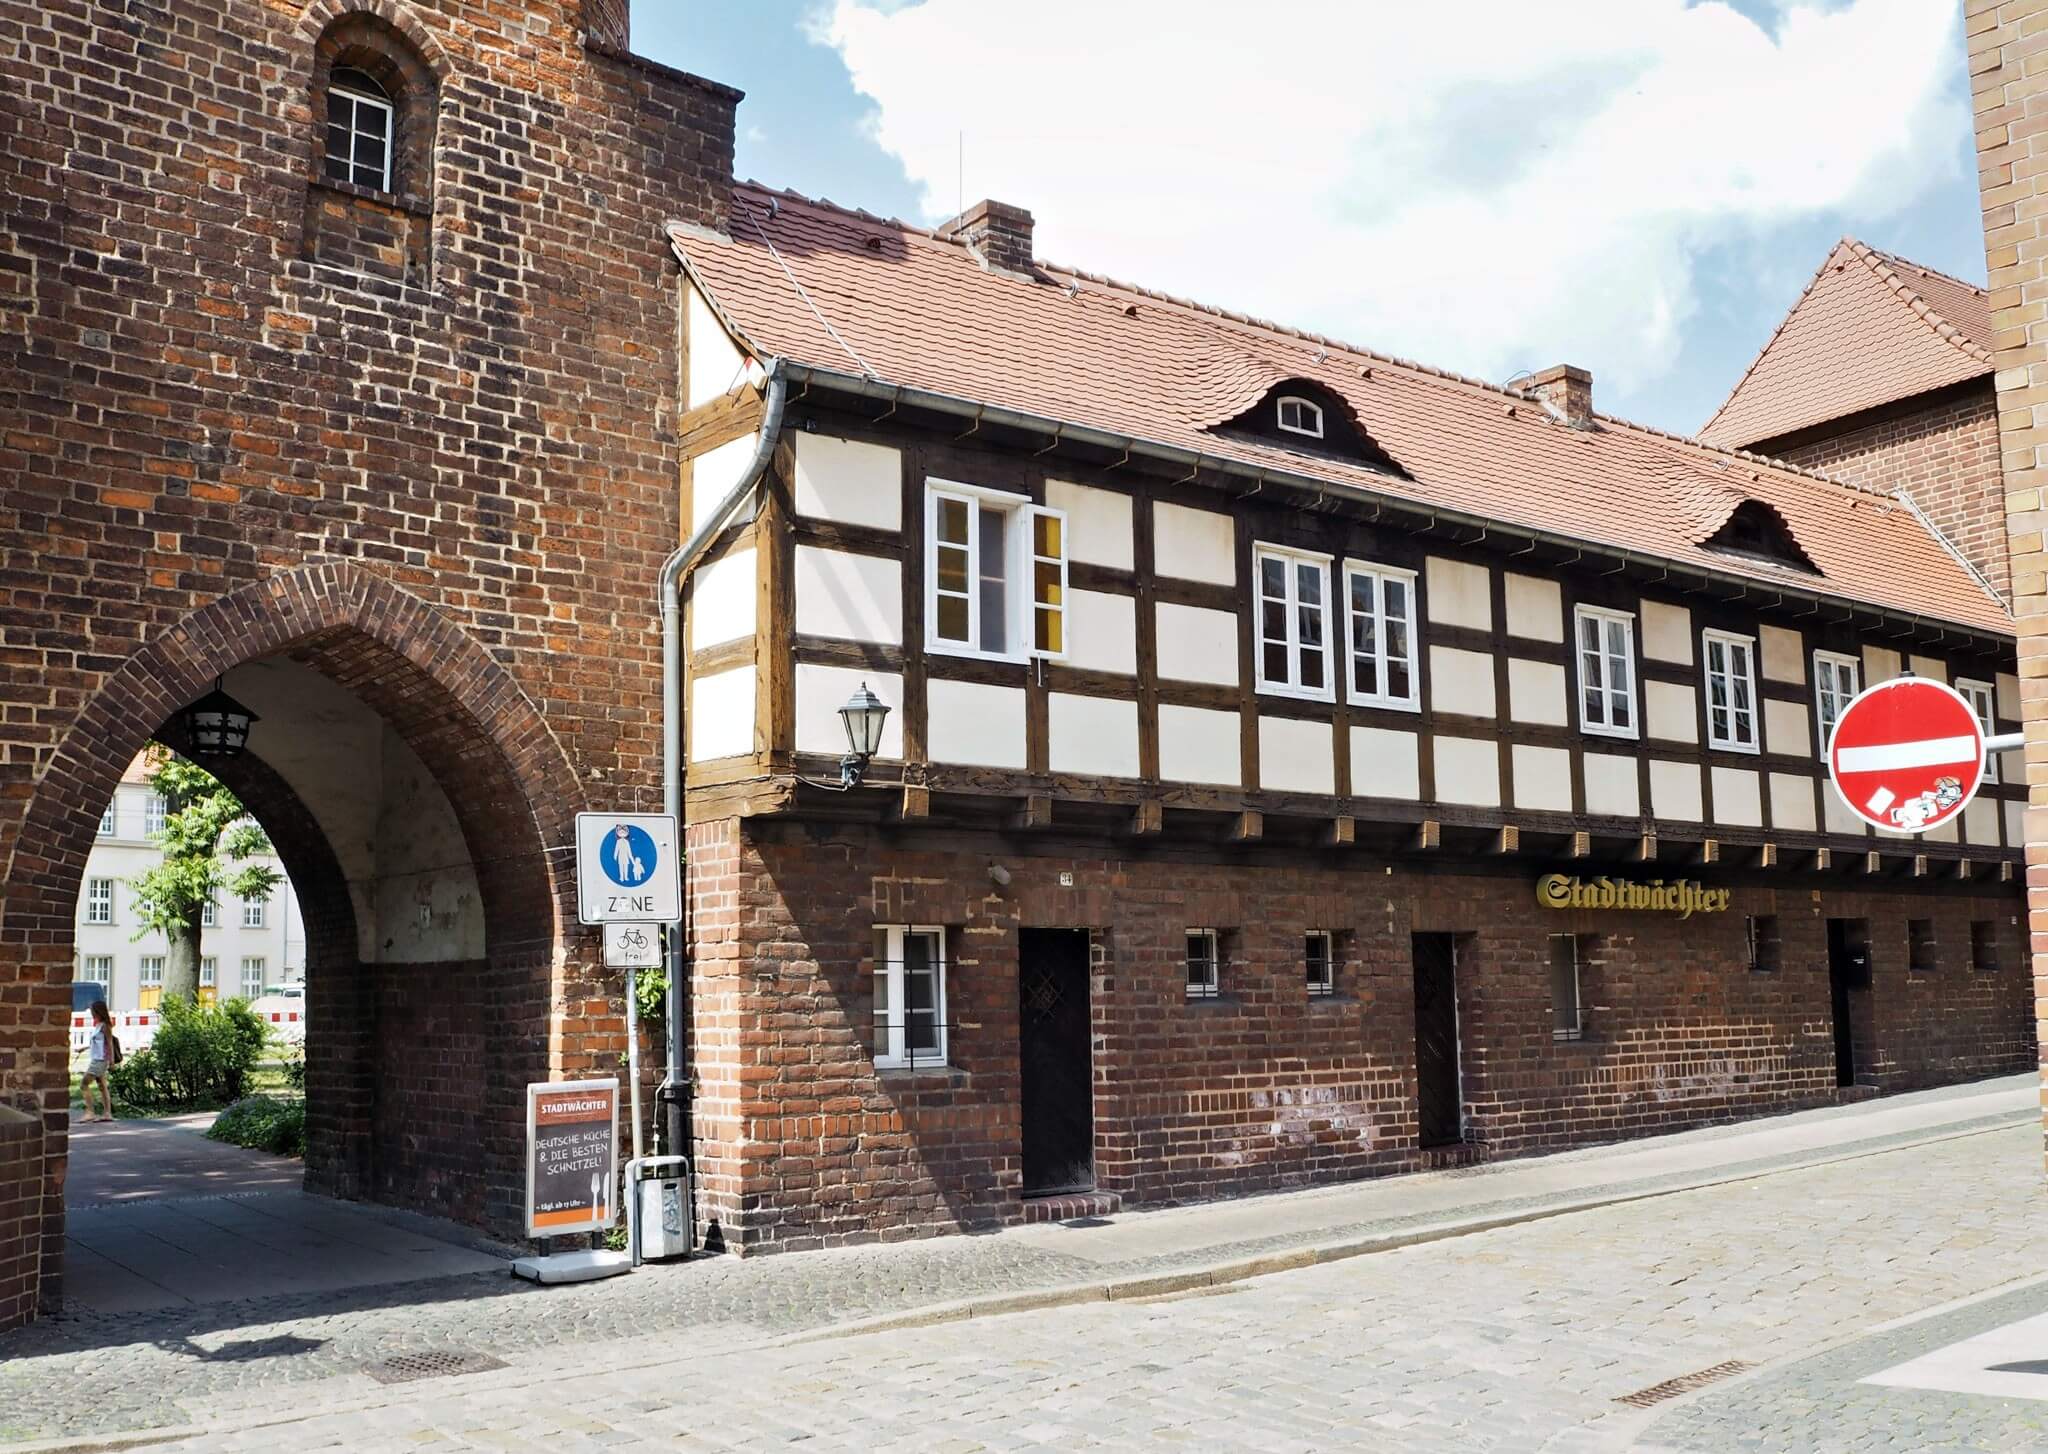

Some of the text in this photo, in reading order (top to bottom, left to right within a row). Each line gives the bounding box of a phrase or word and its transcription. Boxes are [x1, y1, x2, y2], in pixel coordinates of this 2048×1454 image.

[608, 896, 654, 912] ZNE
[1537, 873, 1730, 920] Stadtwächter
[541, 1100, 607, 1114] STADTWÄCHTER
[535, 1129, 610, 1150] DEUTSCHE KÜCHE
[540, 1143, 608, 1162] & DIE BESTEN
[547, 1156, 602, 1175] SCHNITZEL!
